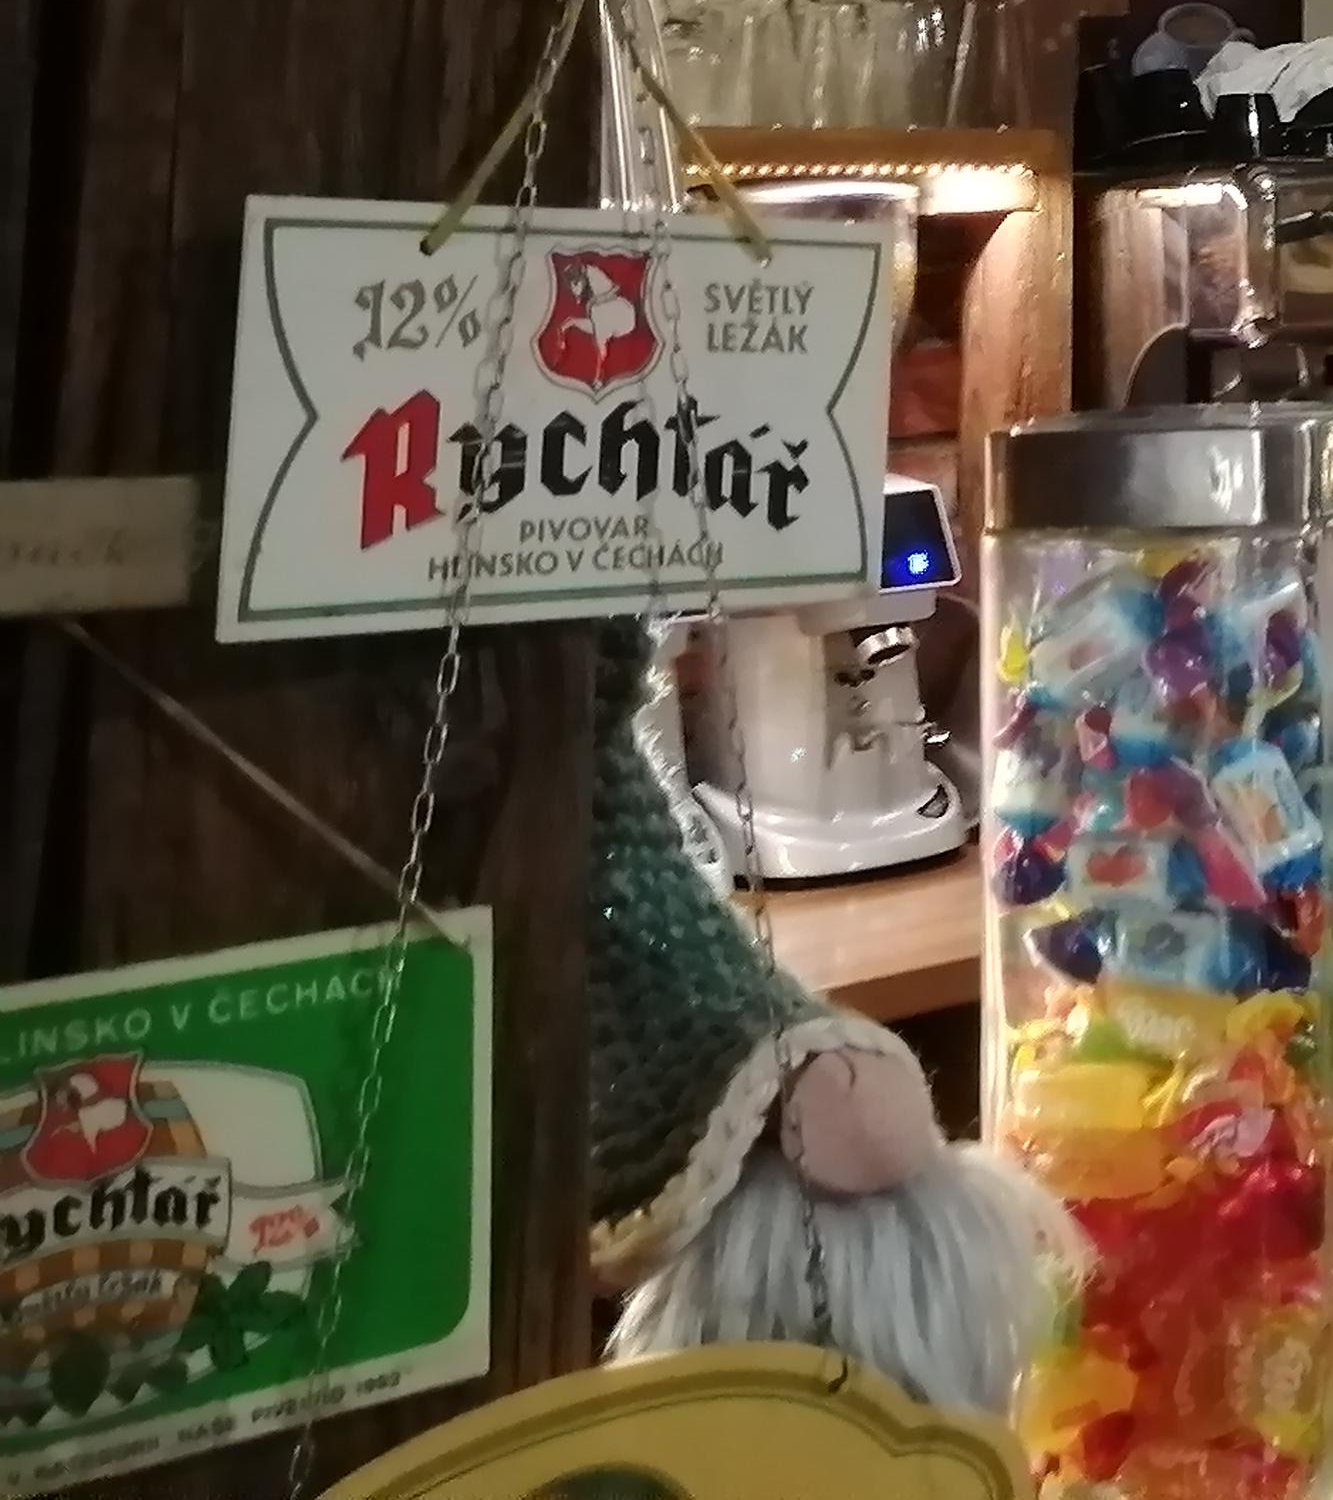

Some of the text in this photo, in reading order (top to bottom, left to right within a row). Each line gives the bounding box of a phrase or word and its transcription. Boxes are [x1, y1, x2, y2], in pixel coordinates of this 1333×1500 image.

[352, 272, 482, 361] 12%
[703, 278, 815, 316] SVĚTLÝ
[706, 319, 809, 355] LEŽÁK
[340, 389, 812, 550] Rychtář
[518, 514, 651, 544] PIVOVAR
[566, 548, 585, 573] V
[0, 1008, 152, 1064] INSKO
[171, 1002, 192, 1031] V
[0, 1165, 222, 1257] ychtář
